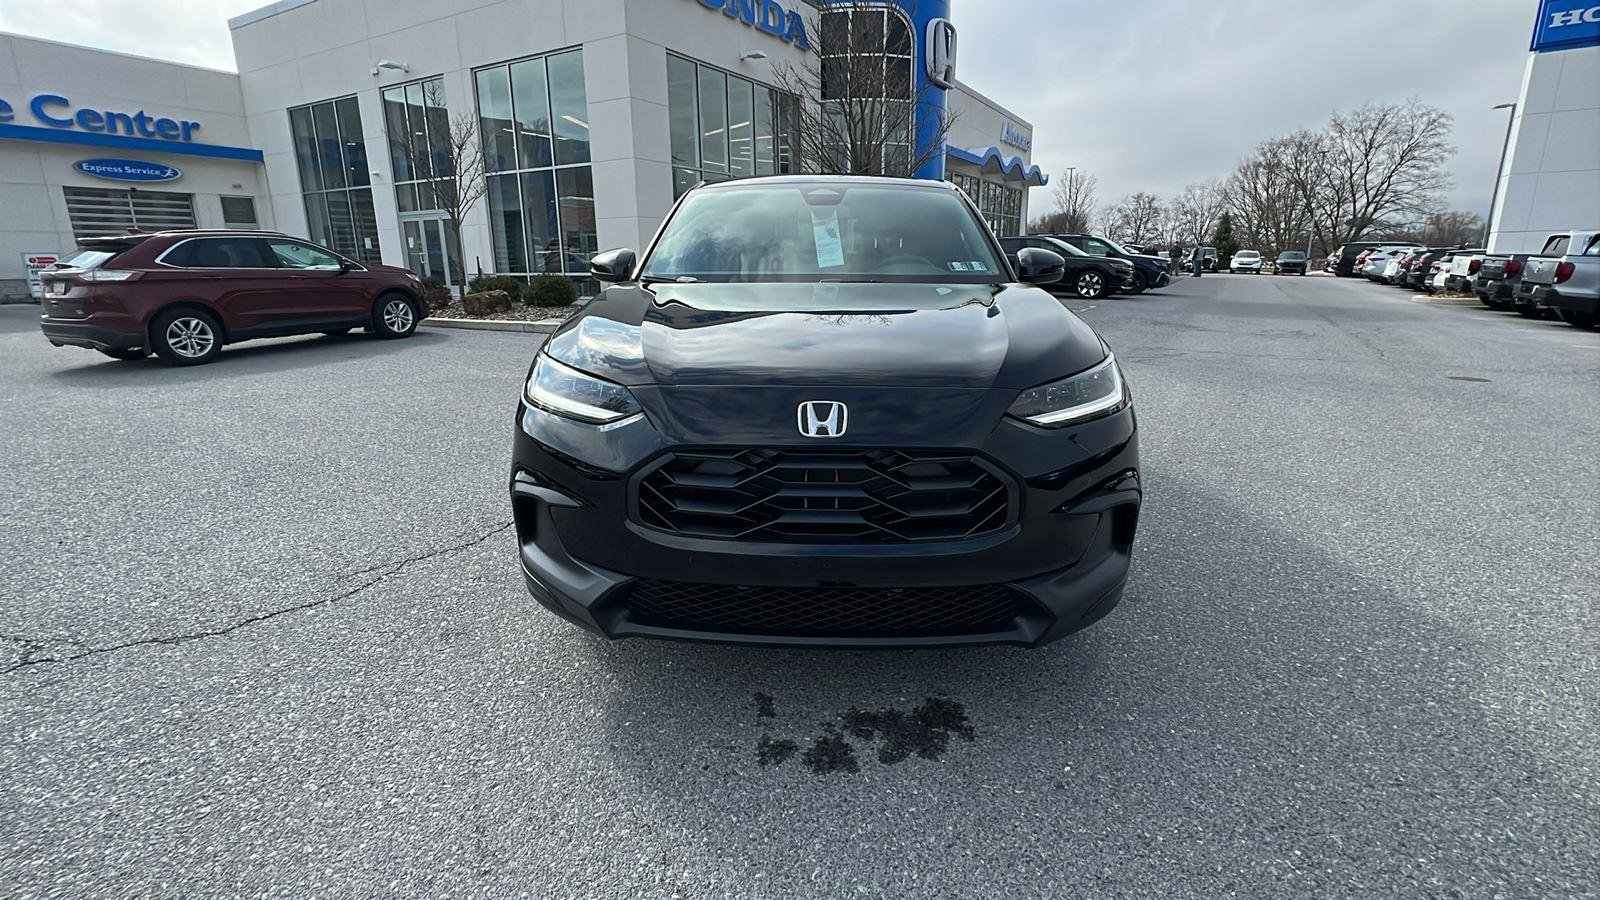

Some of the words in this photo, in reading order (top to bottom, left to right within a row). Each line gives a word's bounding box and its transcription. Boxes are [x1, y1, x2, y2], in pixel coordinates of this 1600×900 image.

[698, 0, 810, 51] NDA
[30, 94, 200, 141] Center
[82, 162, 122, 173] Express
[124, 166, 160, 175] Service
